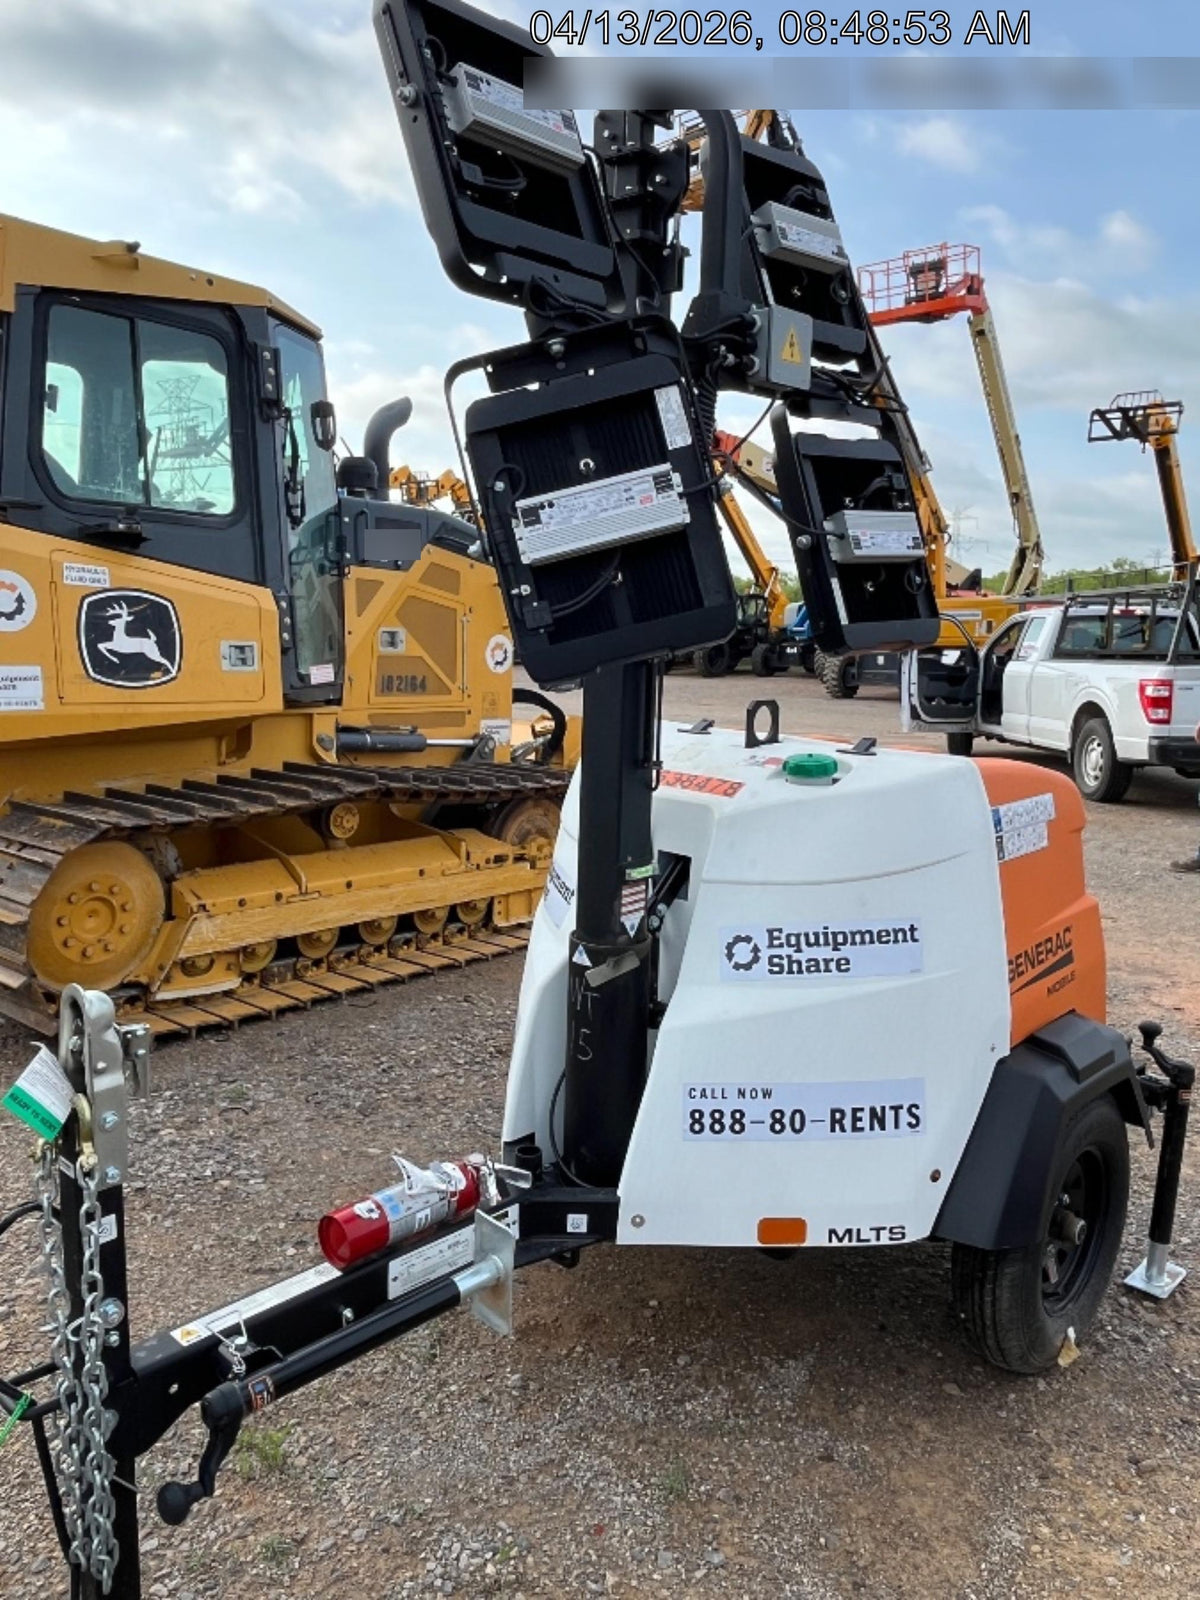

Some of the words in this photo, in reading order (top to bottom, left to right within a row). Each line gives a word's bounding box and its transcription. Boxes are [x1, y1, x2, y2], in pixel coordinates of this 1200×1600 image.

[766, 924, 919, 953] Equipment
[767, 954, 851, 975] Share
[689, 1087, 728, 1100] CALL
[737, 1087, 773, 1100] NOW
[689, 1103, 921, 1135] 888-80-RENTS
[828, 1226, 906, 1244] MLTS
